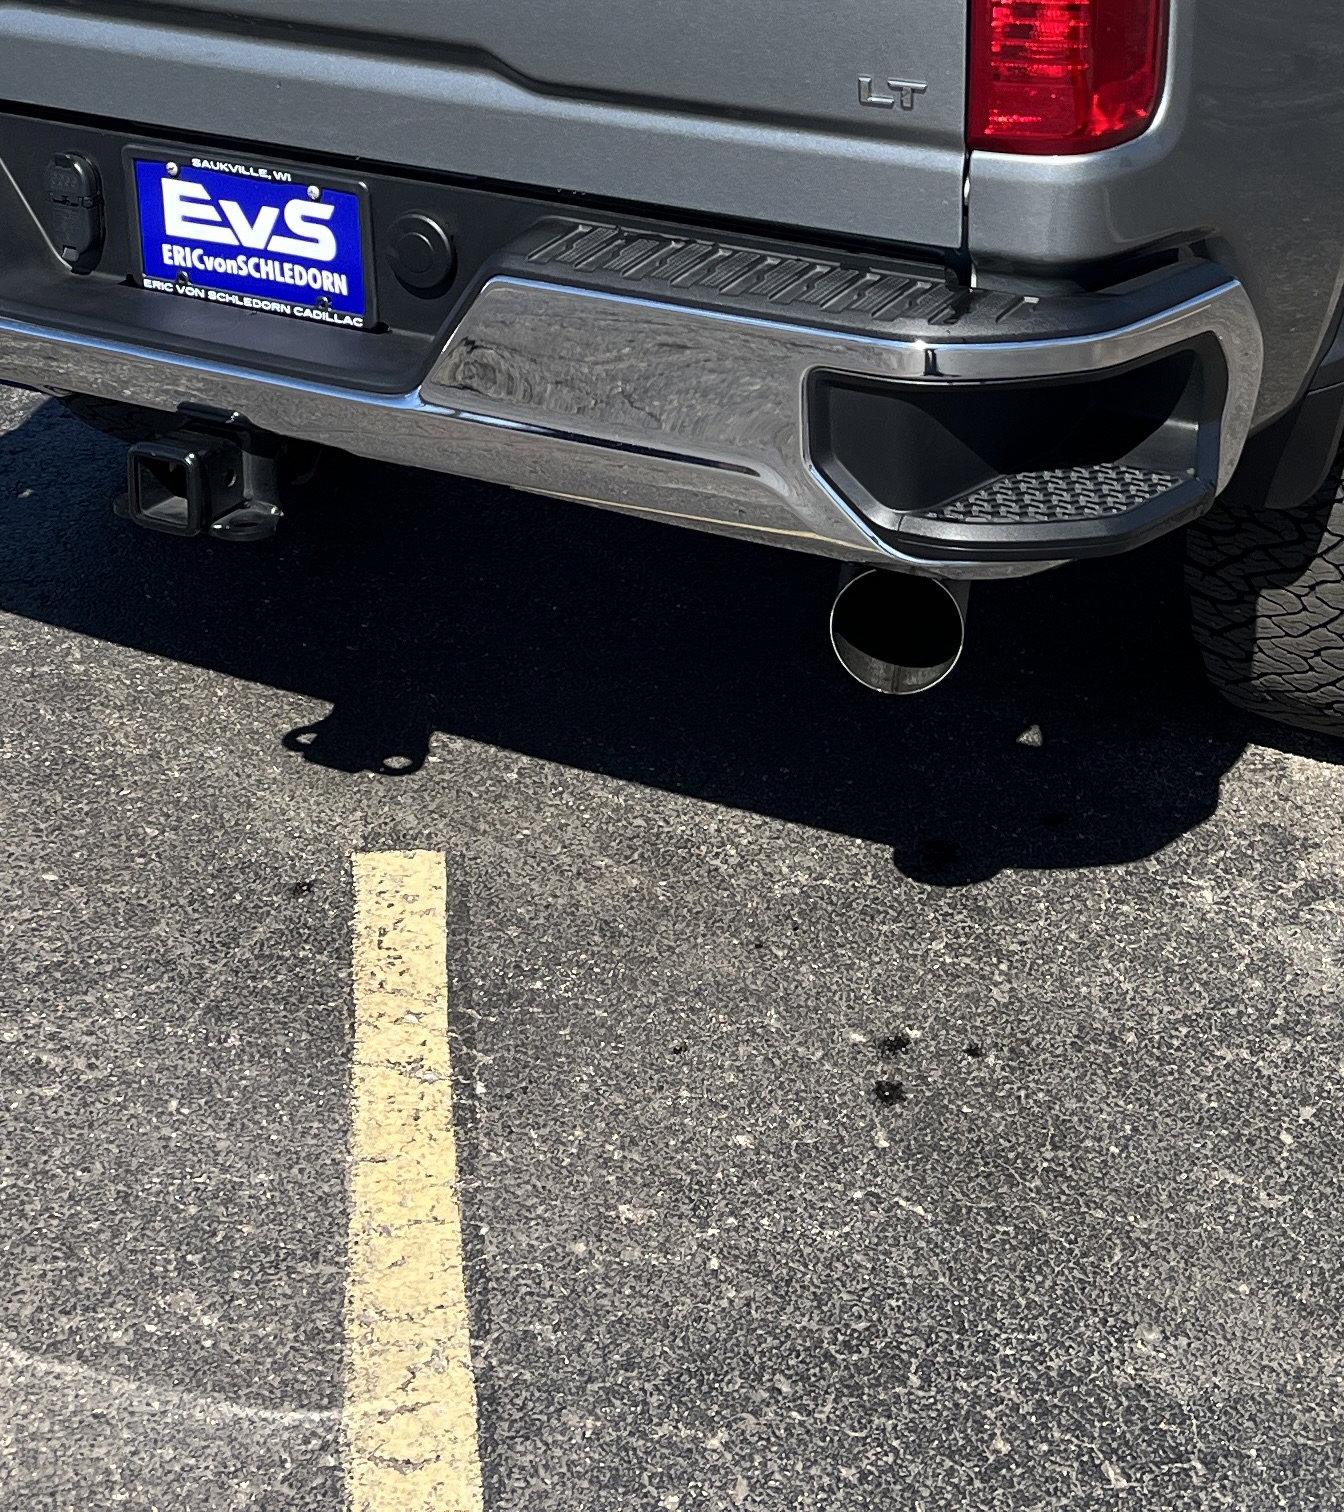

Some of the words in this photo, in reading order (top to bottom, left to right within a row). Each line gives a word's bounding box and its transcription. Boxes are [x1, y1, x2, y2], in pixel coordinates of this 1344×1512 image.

[858, 73, 928, 110] LT
[191, 158, 272, 180] SAUKVILLE,
[273, 171, 292, 182] WI
[143, 279, 173, 292] ERIC
[176, 284, 205, 298] VON
[207, 290, 291, 314] SCHLEDORN
[293, 306, 364, 328] CADILLAC
